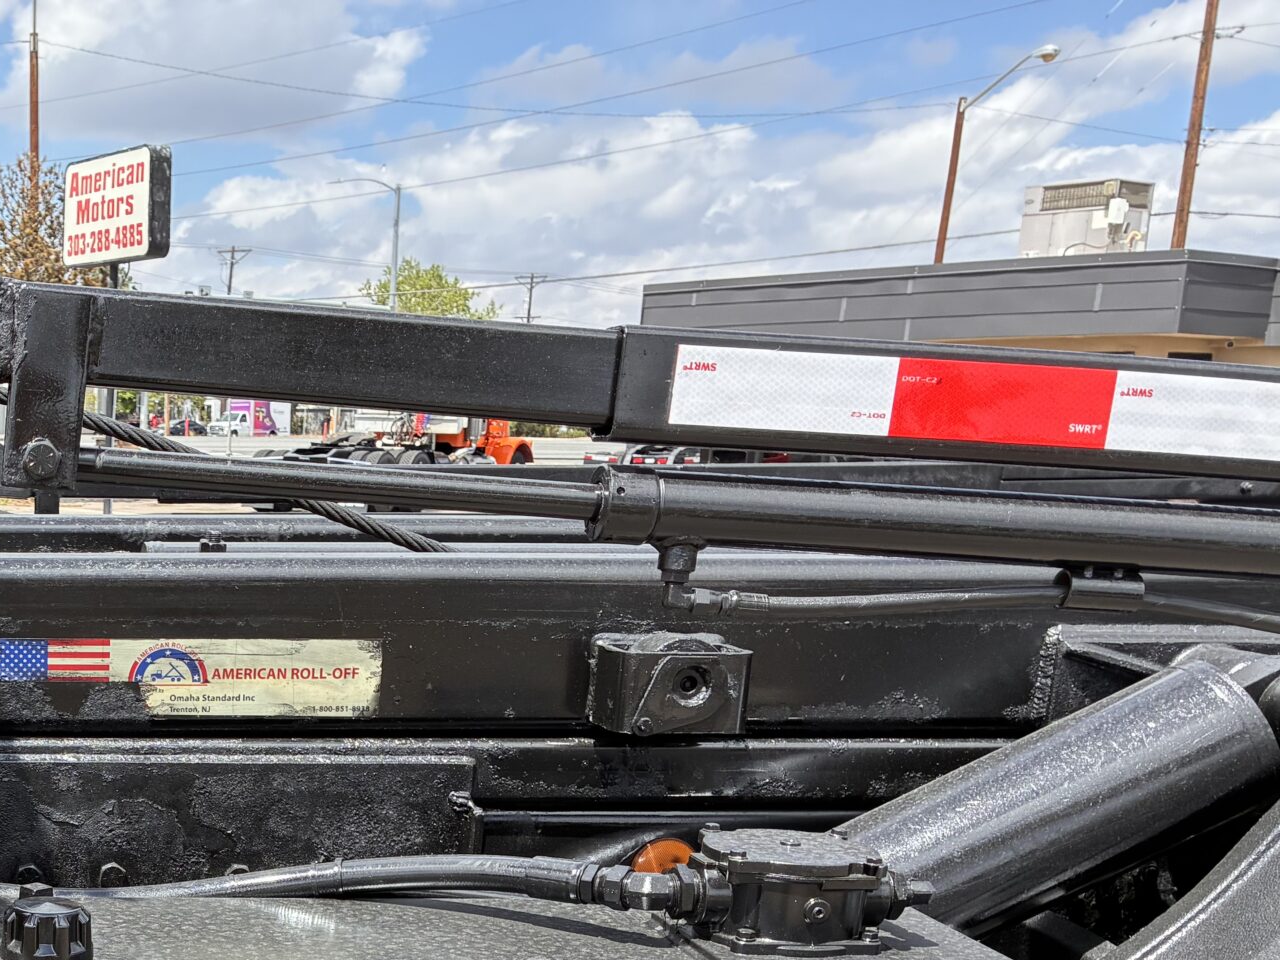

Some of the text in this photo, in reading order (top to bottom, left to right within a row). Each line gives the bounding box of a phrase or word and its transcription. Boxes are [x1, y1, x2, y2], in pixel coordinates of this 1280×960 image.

[69, 162, 145, 198] American
[76, 194, 134, 225] Motors
[67, 223, 143, 257] 303-288-4885
[136, 642, 170, 662] AMERICAN
[212, 667, 360, 680] AMERICAN ROLL-OFF
[170, 694, 200, 702] Omaha
[202, 694, 240, 702] Standard
